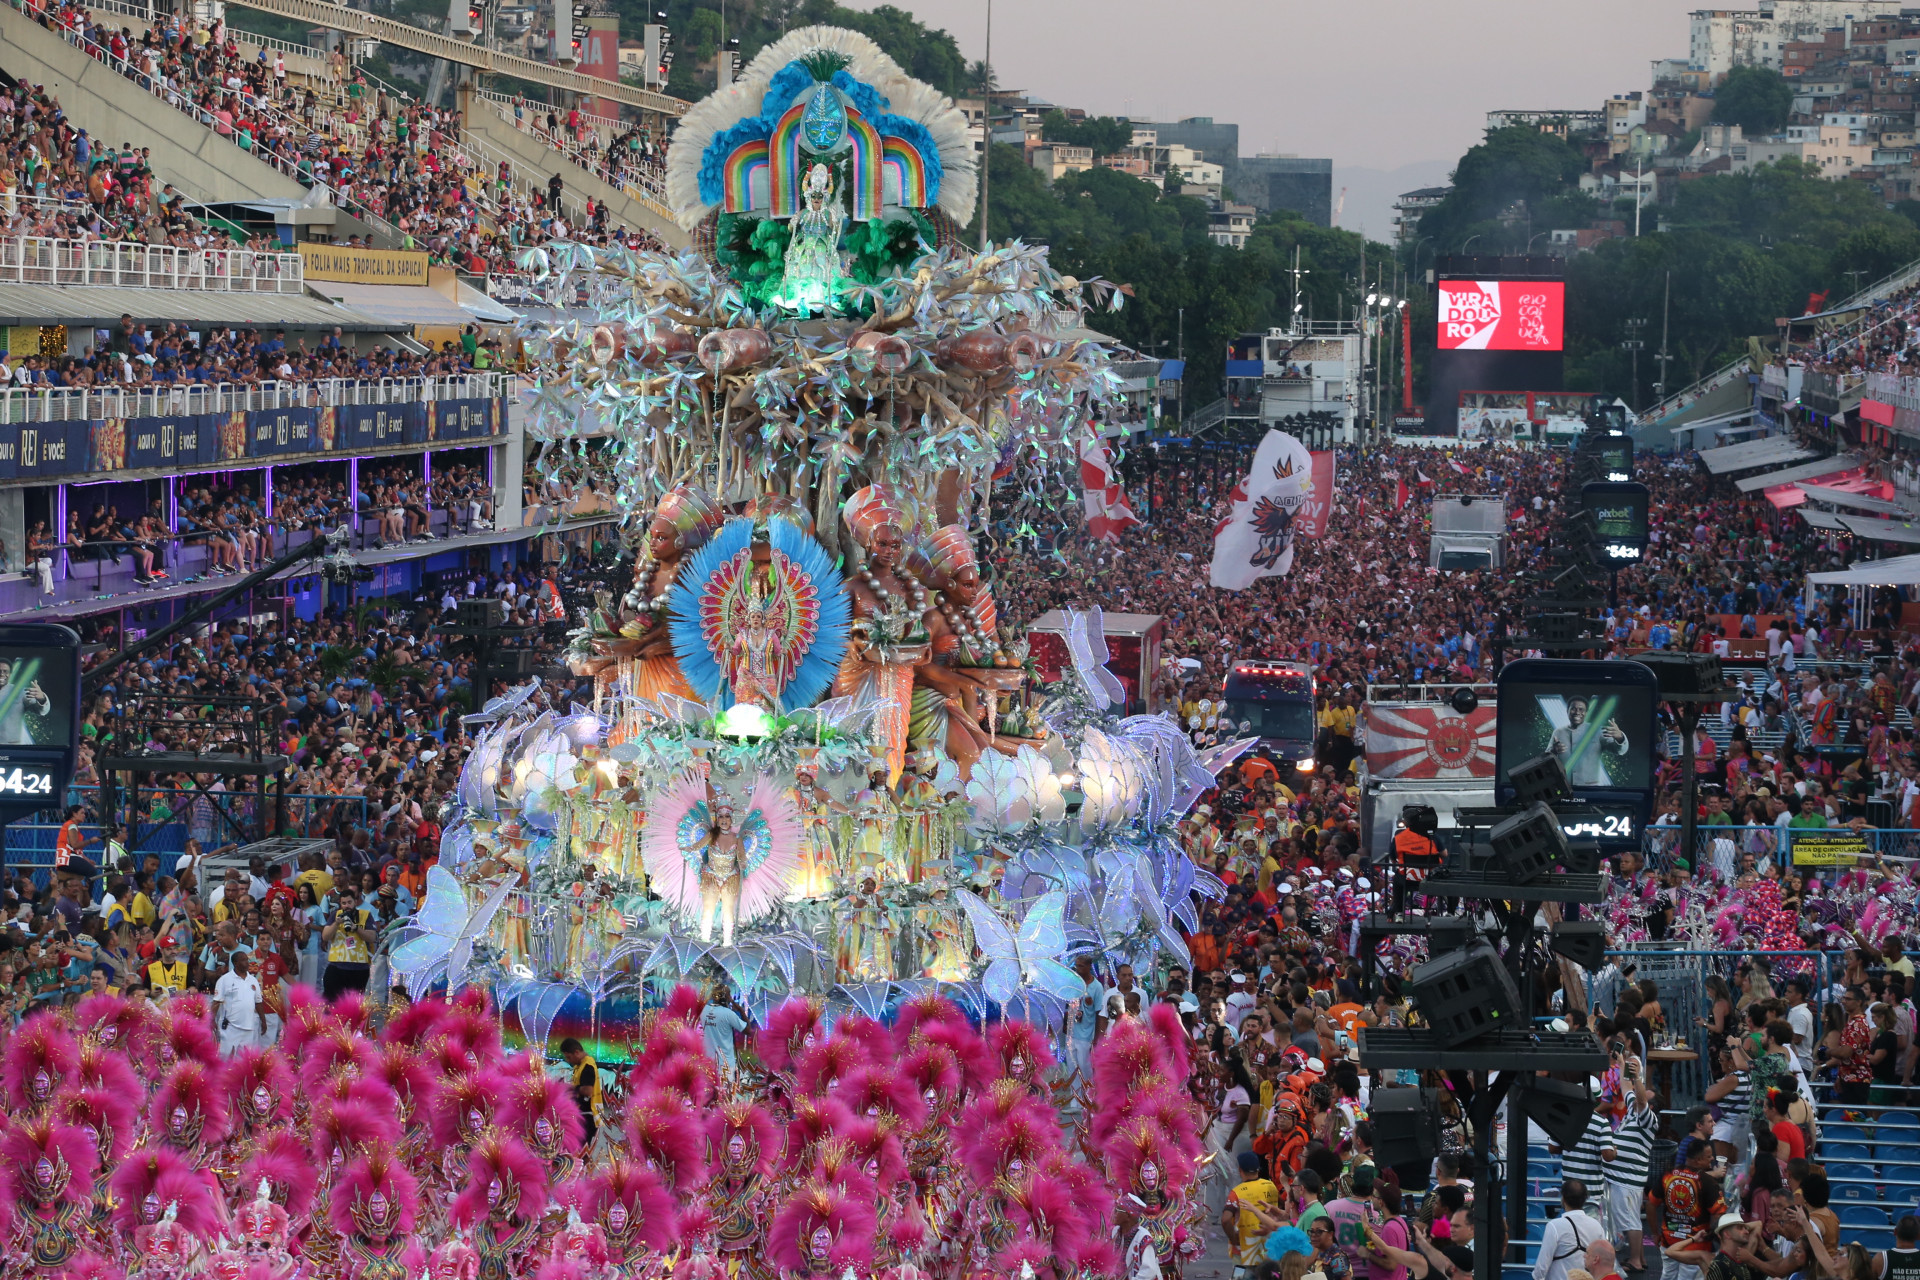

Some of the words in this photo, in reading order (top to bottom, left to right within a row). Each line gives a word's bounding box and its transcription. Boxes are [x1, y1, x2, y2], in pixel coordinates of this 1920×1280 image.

[303, 253, 308, 268] A
[311, 253, 331, 272] FOLIA
[333, 256, 350, 274] MAIS
[353, 257, 385, 276] TROPICAL
[386, 258, 396, 276] DA
[397, 257, 424, 277] SAPUCAÍ
[1448, 292, 1494, 307] VIRA
[1447, 307, 1491, 323] DOU
[1446, 322, 1476, 338] RO
[268, 424, 273, 439] O
[276, 415, 289, 446] REI
[292, 421, 296, 439] É
[9, 442, 15, 460] O
[20, 429, 38, 467] REI
[42, 438, 48, 461] É
[137, 433, 151, 451] AQUI
[151, 433, 156, 449] O
[161, 424, 175, 458] REI
[178, 431, 183, 451] É
[1598, 507, 1630, 520] pixbet
[1892, 1267, 1905, 1275] NÃO
